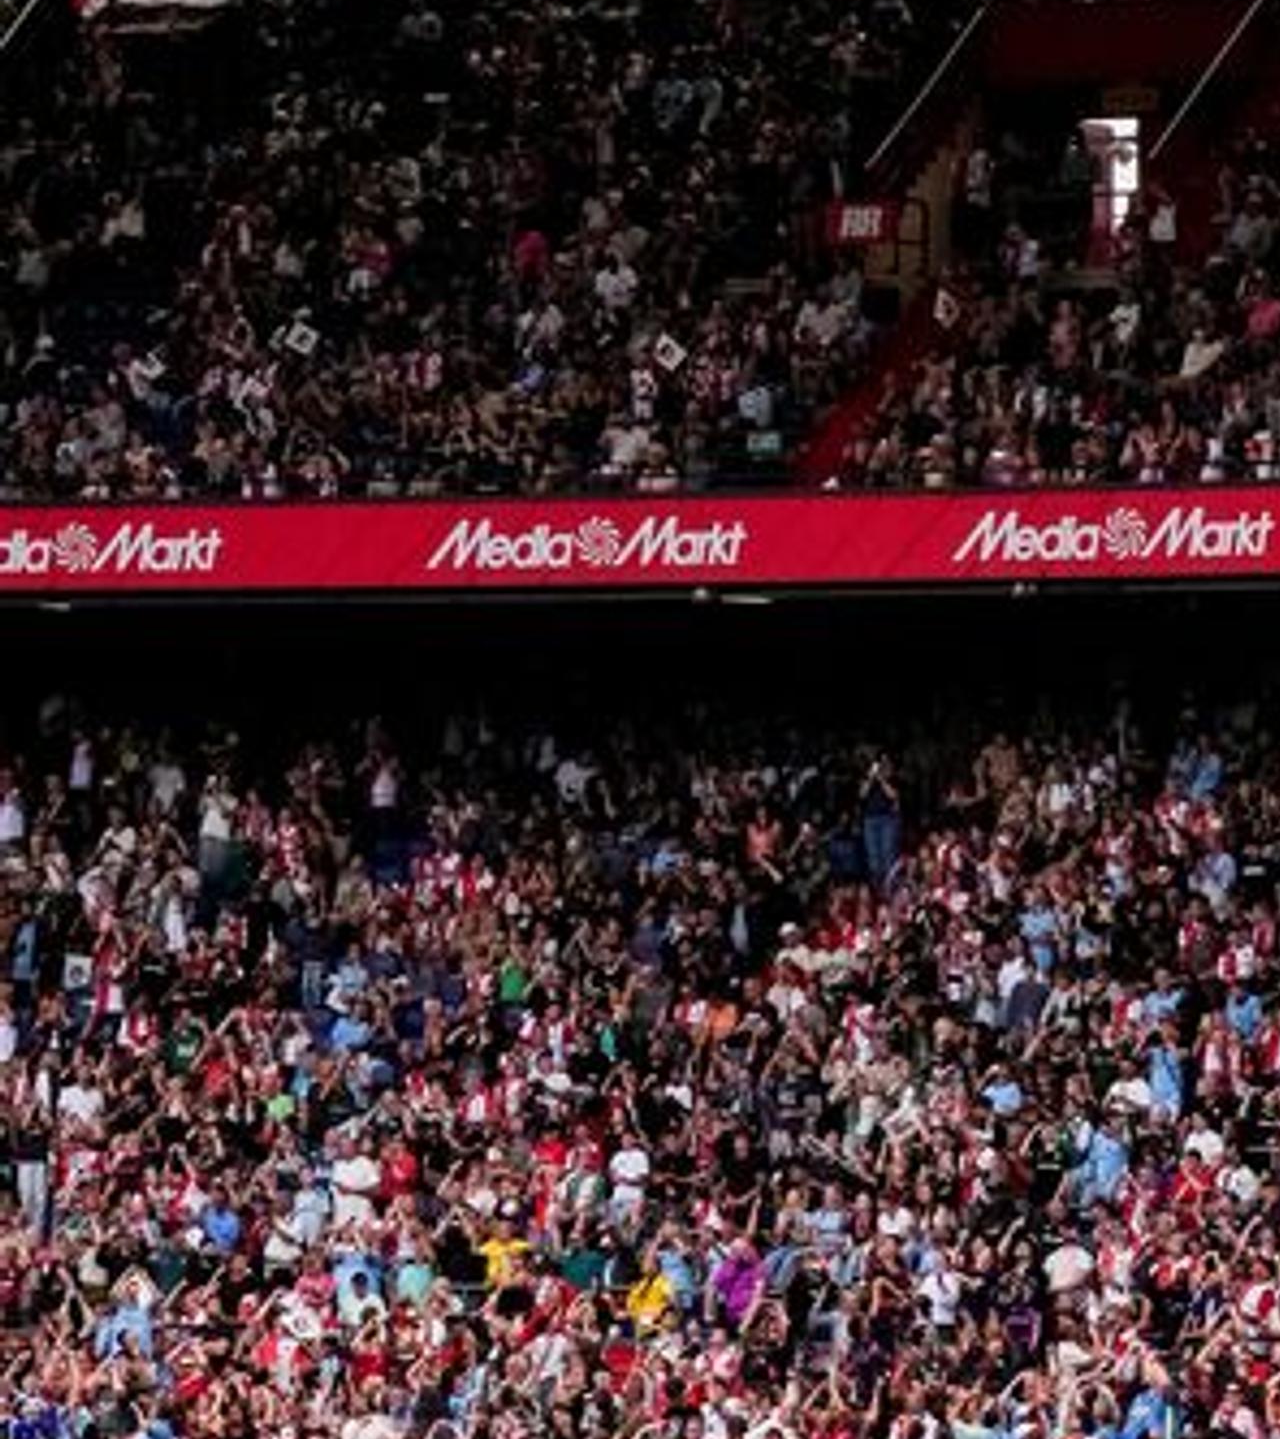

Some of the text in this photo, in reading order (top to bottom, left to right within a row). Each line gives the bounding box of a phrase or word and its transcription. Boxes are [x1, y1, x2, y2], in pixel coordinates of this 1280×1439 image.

[90, 522, 222, 572] Markt
[426, 515, 748, 569] Media Markt
[952, 506, 1275, 561] Media Markt
